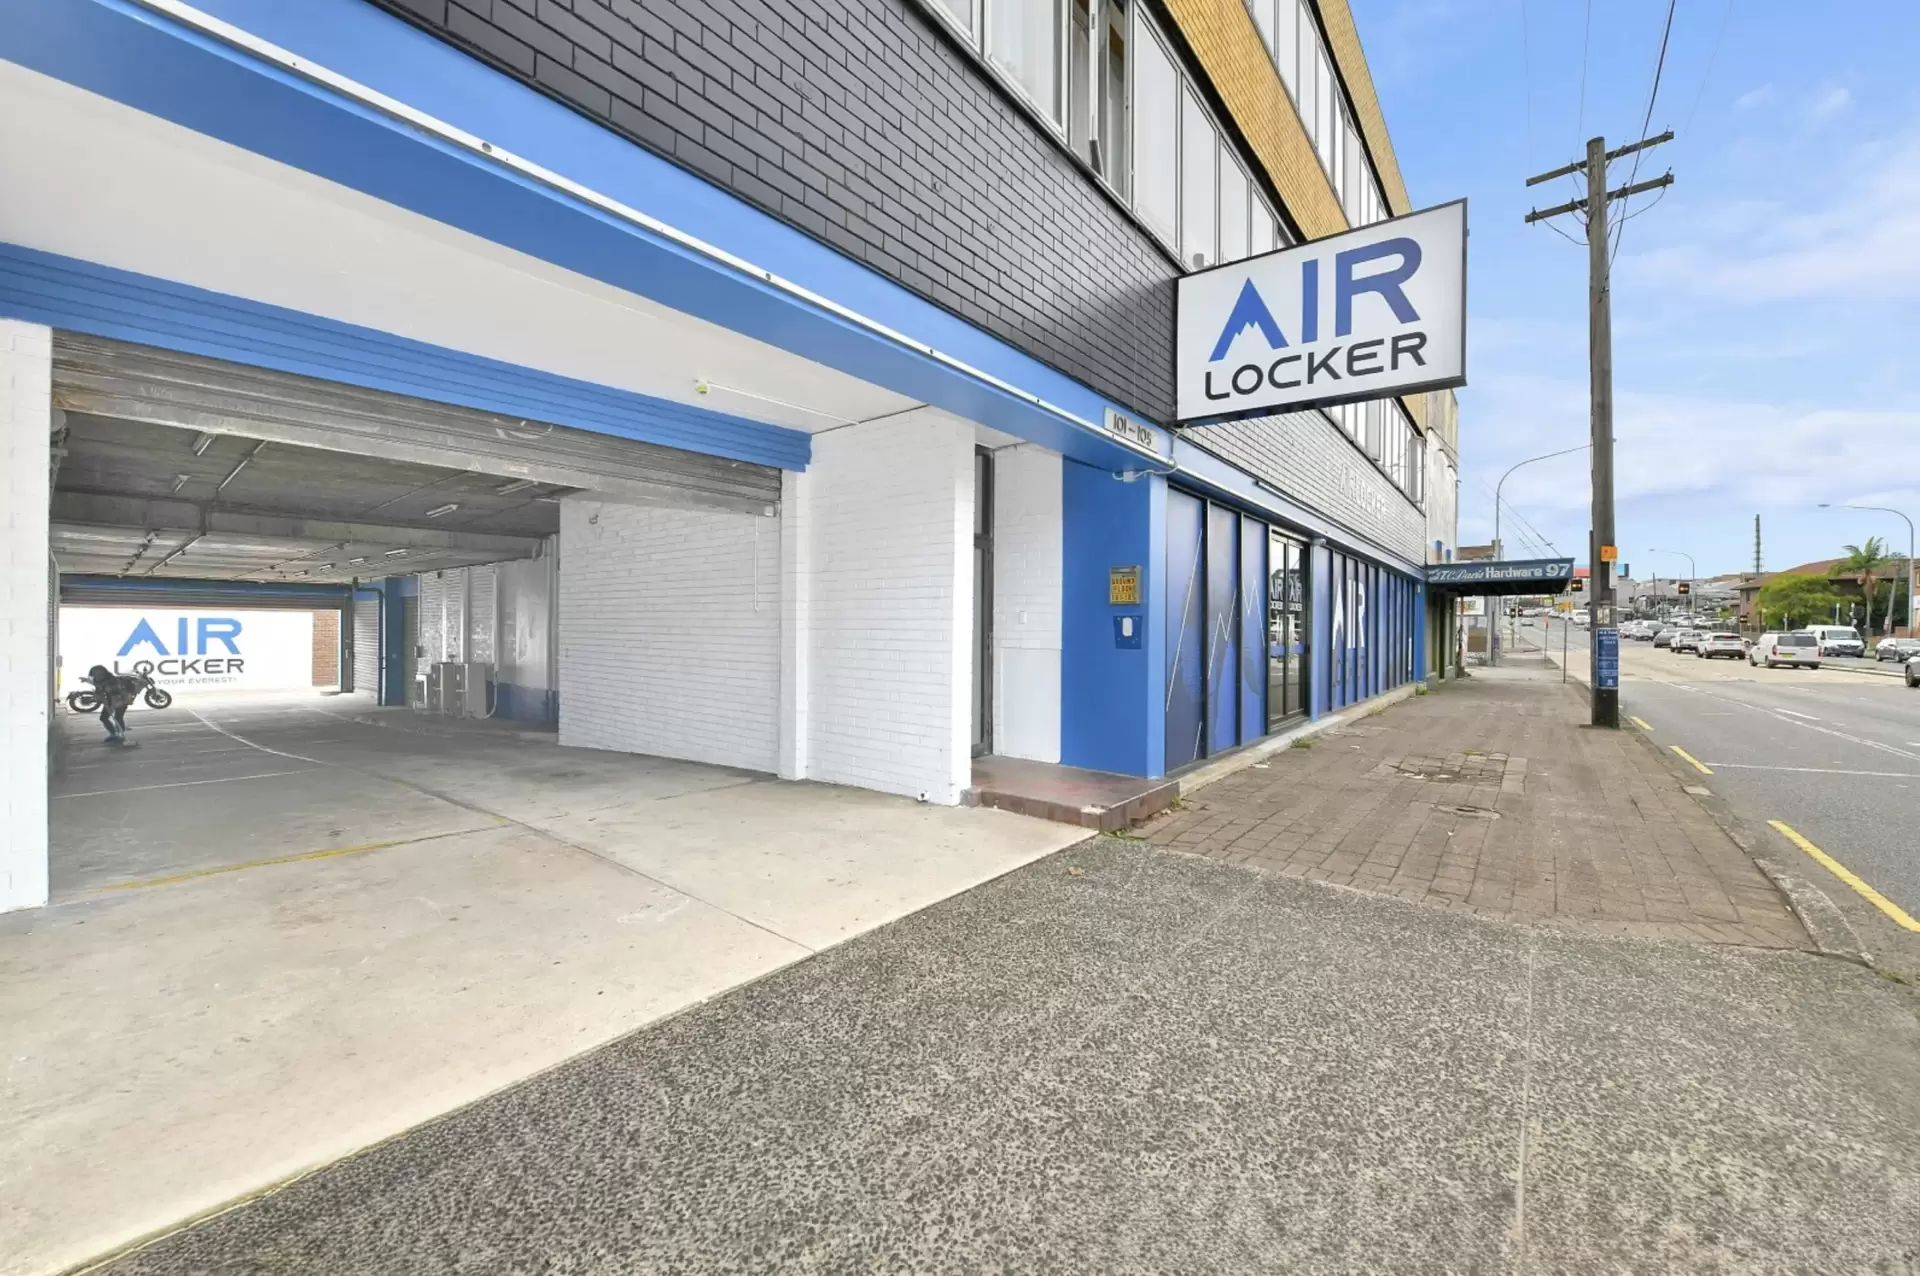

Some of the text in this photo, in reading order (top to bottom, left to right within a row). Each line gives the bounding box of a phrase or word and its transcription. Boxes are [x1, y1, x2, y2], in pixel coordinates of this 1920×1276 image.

[1208, 237, 1422, 362] AIR
[1204, 331, 1427, 400] LOCKER
[1485, 566, 1543, 579] Hardware
[1545, 563, 1571, 577] 97
[116, 617, 243, 656] AIR
[113, 658, 245, 676] LOCKER
